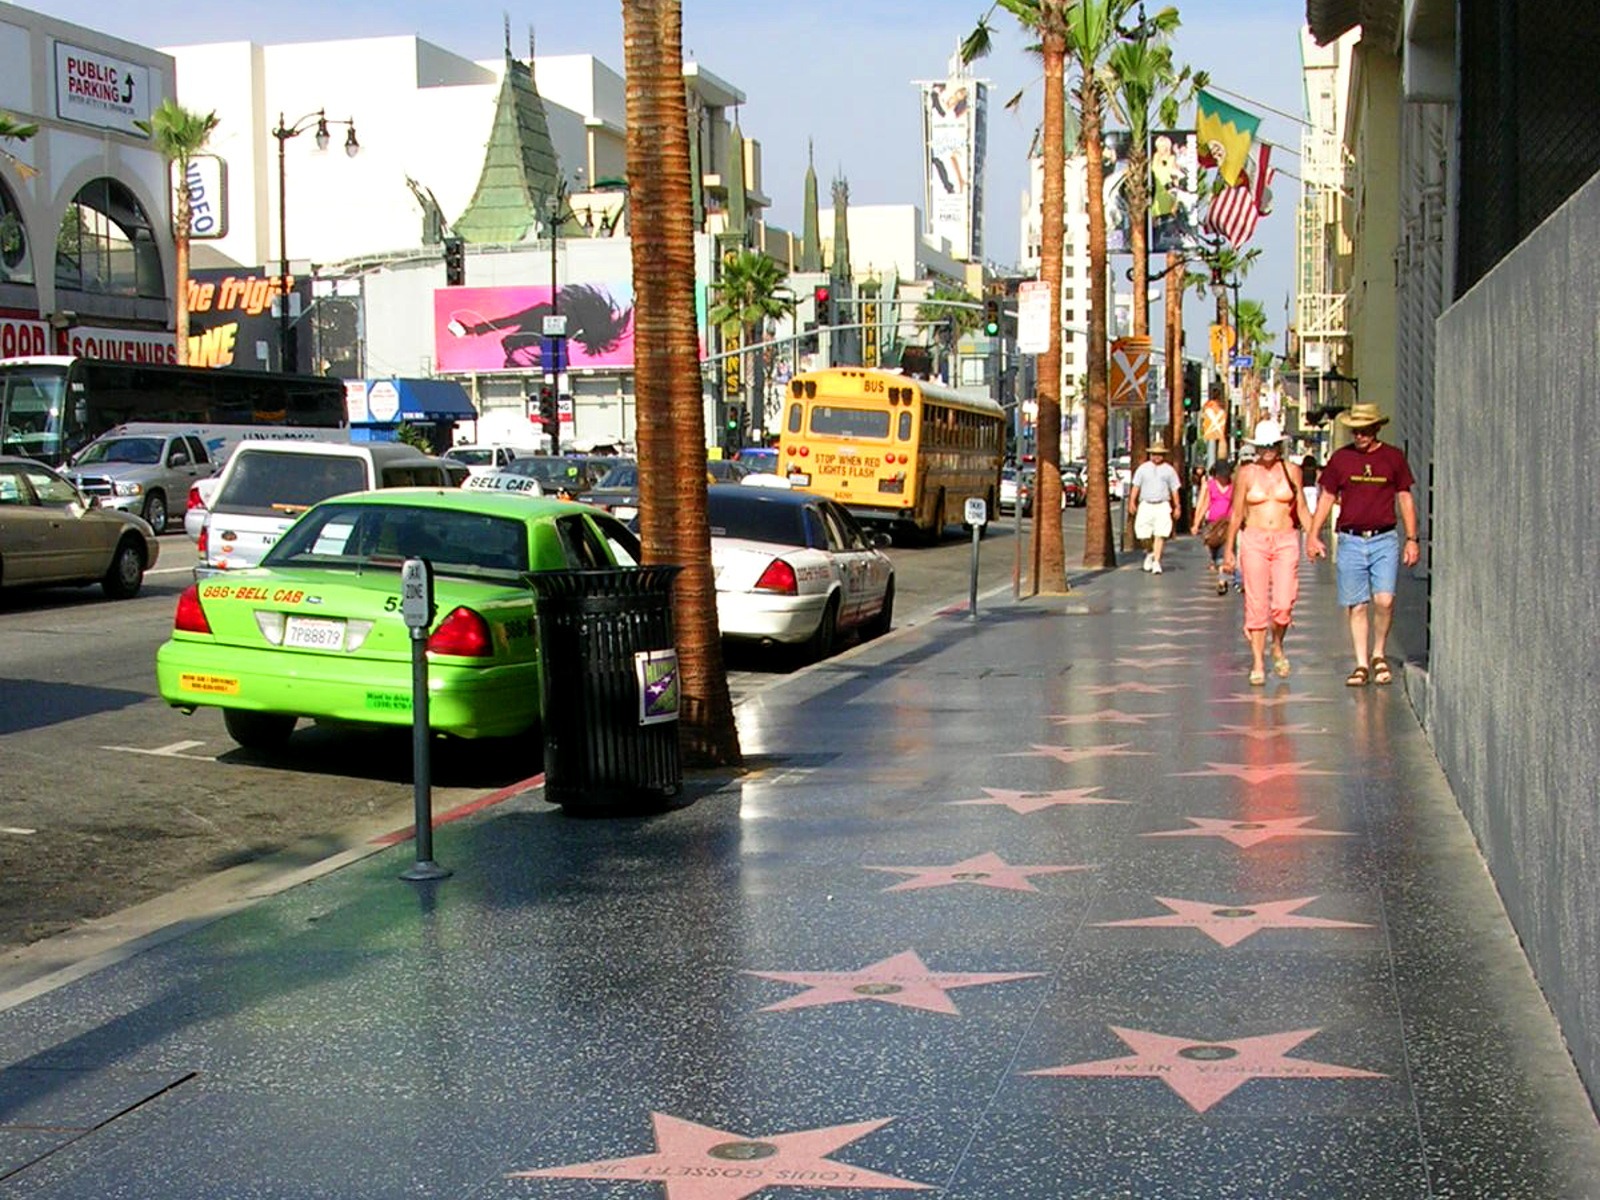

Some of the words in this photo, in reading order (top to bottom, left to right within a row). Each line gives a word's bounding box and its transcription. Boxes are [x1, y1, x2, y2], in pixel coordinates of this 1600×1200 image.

[68, 57, 118, 84] PUBLIC
[68, 76, 120, 103] PARKING
[187, 279, 215, 312] he
[2, 323, 46, 358] OOD
[72, 336, 177, 365] SOUVENIRS
[864, 380, 885, 393] BUS
[815, 454, 836, 464] STOP
[839, 456, 862, 466] WHEN
[864, 457, 881, 468] RED
[818, 465, 846, 476] LIGHTS
[849, 467, 875, 478] FLASH
[470, 476, 502, 489] BELL
[506, 479, 535, 491] CAB
[273, 589, 304, 603] CAB
[406, 583, 423, 599] ZONE
[291, 626, 341, 645] 7P88879
[640, 1166, 764, 1180] GOSSETT
[775, 1169, 858, 1182] LOUIS
